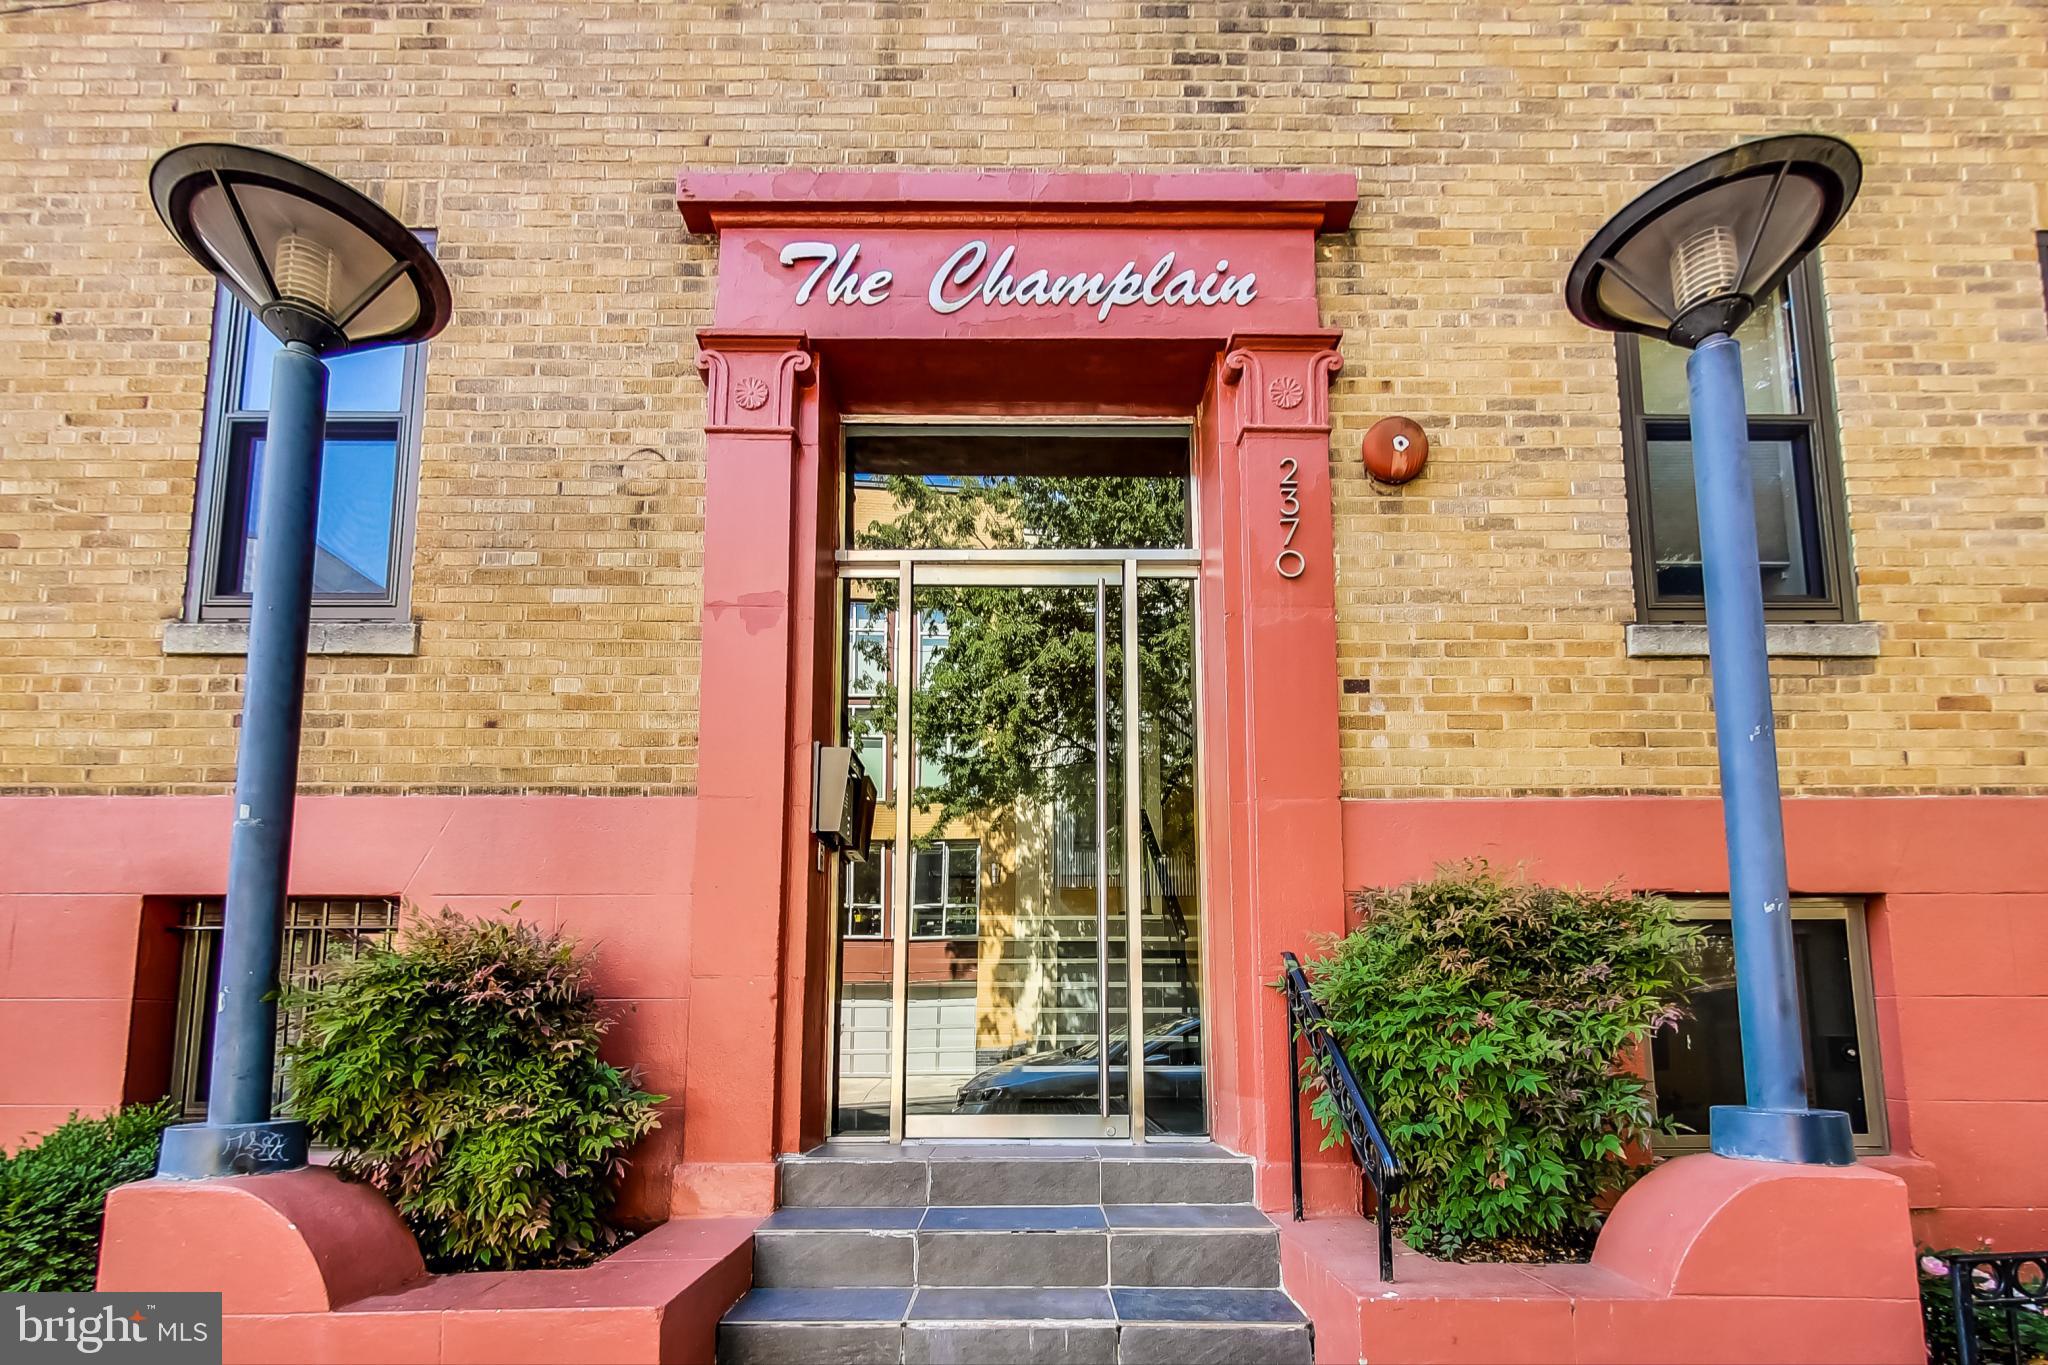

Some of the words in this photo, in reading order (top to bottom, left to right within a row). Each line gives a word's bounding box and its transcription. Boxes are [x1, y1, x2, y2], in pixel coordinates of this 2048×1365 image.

[779, 241, 894, 306] The
[928, 240, 1257, 322] Champlain
[1276, 457, 1306, 578] 2370
